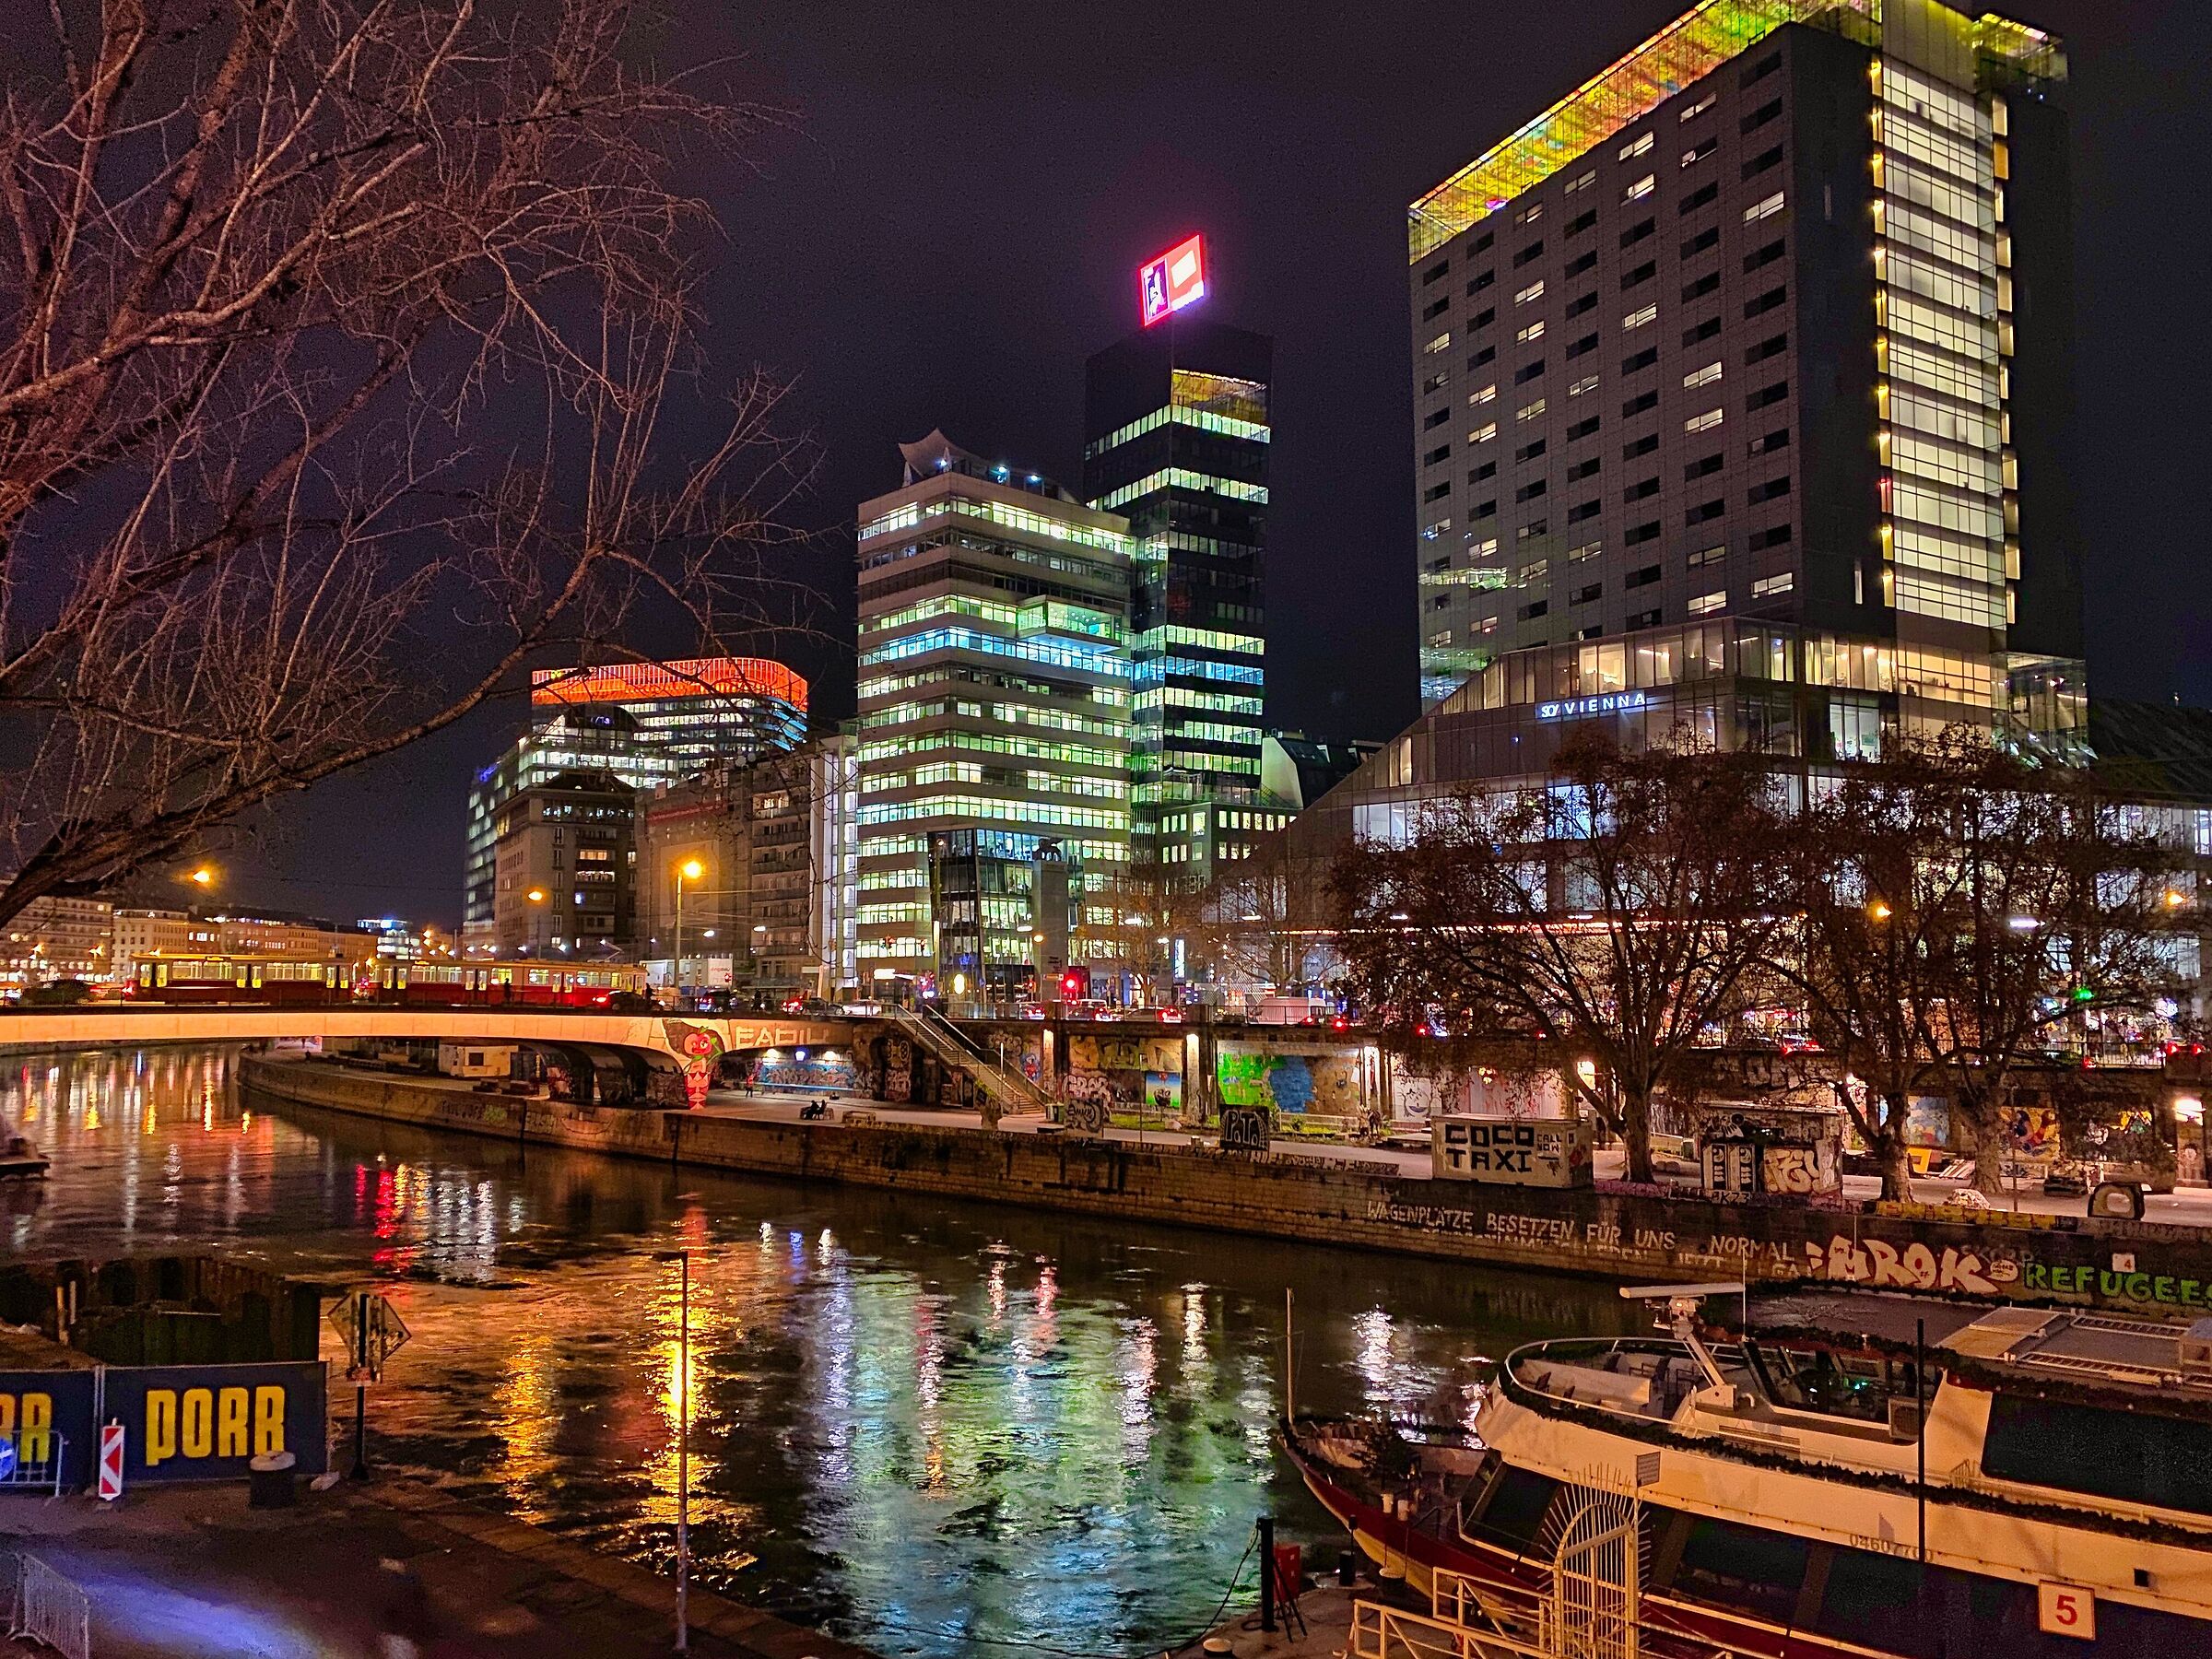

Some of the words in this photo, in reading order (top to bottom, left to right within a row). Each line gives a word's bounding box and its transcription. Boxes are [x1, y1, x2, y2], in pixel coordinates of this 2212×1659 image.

[1564, 693, 1645, 715] VIENNA
[1445, 1124, 1535, 1147] COCO
[1537, 1134, 1562, 1143] CALL
[1537, 1143, 1559, 1153] NOW
[1446, 1148, 1533, 1172] TAXI
[1368, 1200, 1474, 1230] WAGENPLÄTZE
[1487, 1212, 1575, 1240] BESETZEN
[1586, 1221, 1622, 1244] FÜR
[1635, 1229, 1677, 1250] UNS
[1711, 1235, 1795, 1262] NORMAL
[2124, 1259, 2133, 1270] 4
[146, 1385, 286, 1466] PORR
[2055, 1594, 2078, 1627] 5
